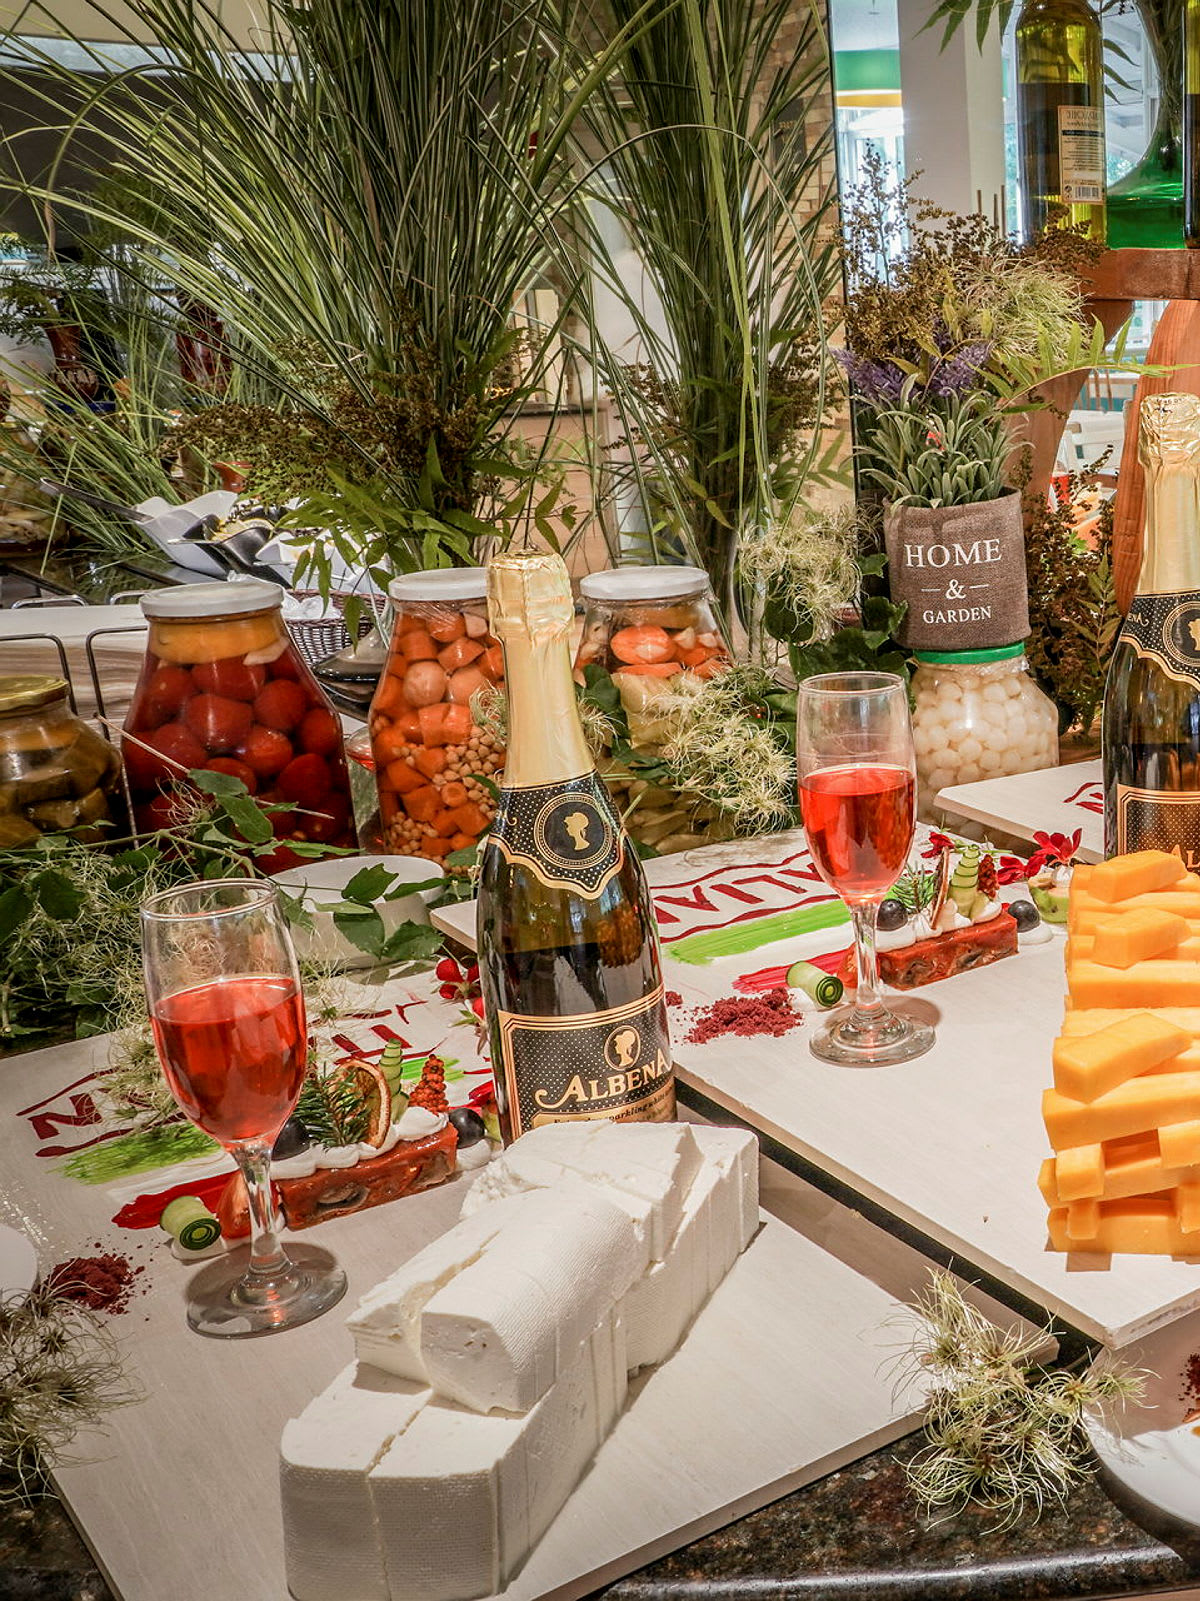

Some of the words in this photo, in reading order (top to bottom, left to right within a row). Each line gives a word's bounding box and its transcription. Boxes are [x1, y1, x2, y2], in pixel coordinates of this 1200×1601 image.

[903, 538, 1003, 568] HOME
[945, 579, 967, 600] &
[922, 606, 992, 624] GARDEN
[534, 1048, 674, 1109] ALBENA
